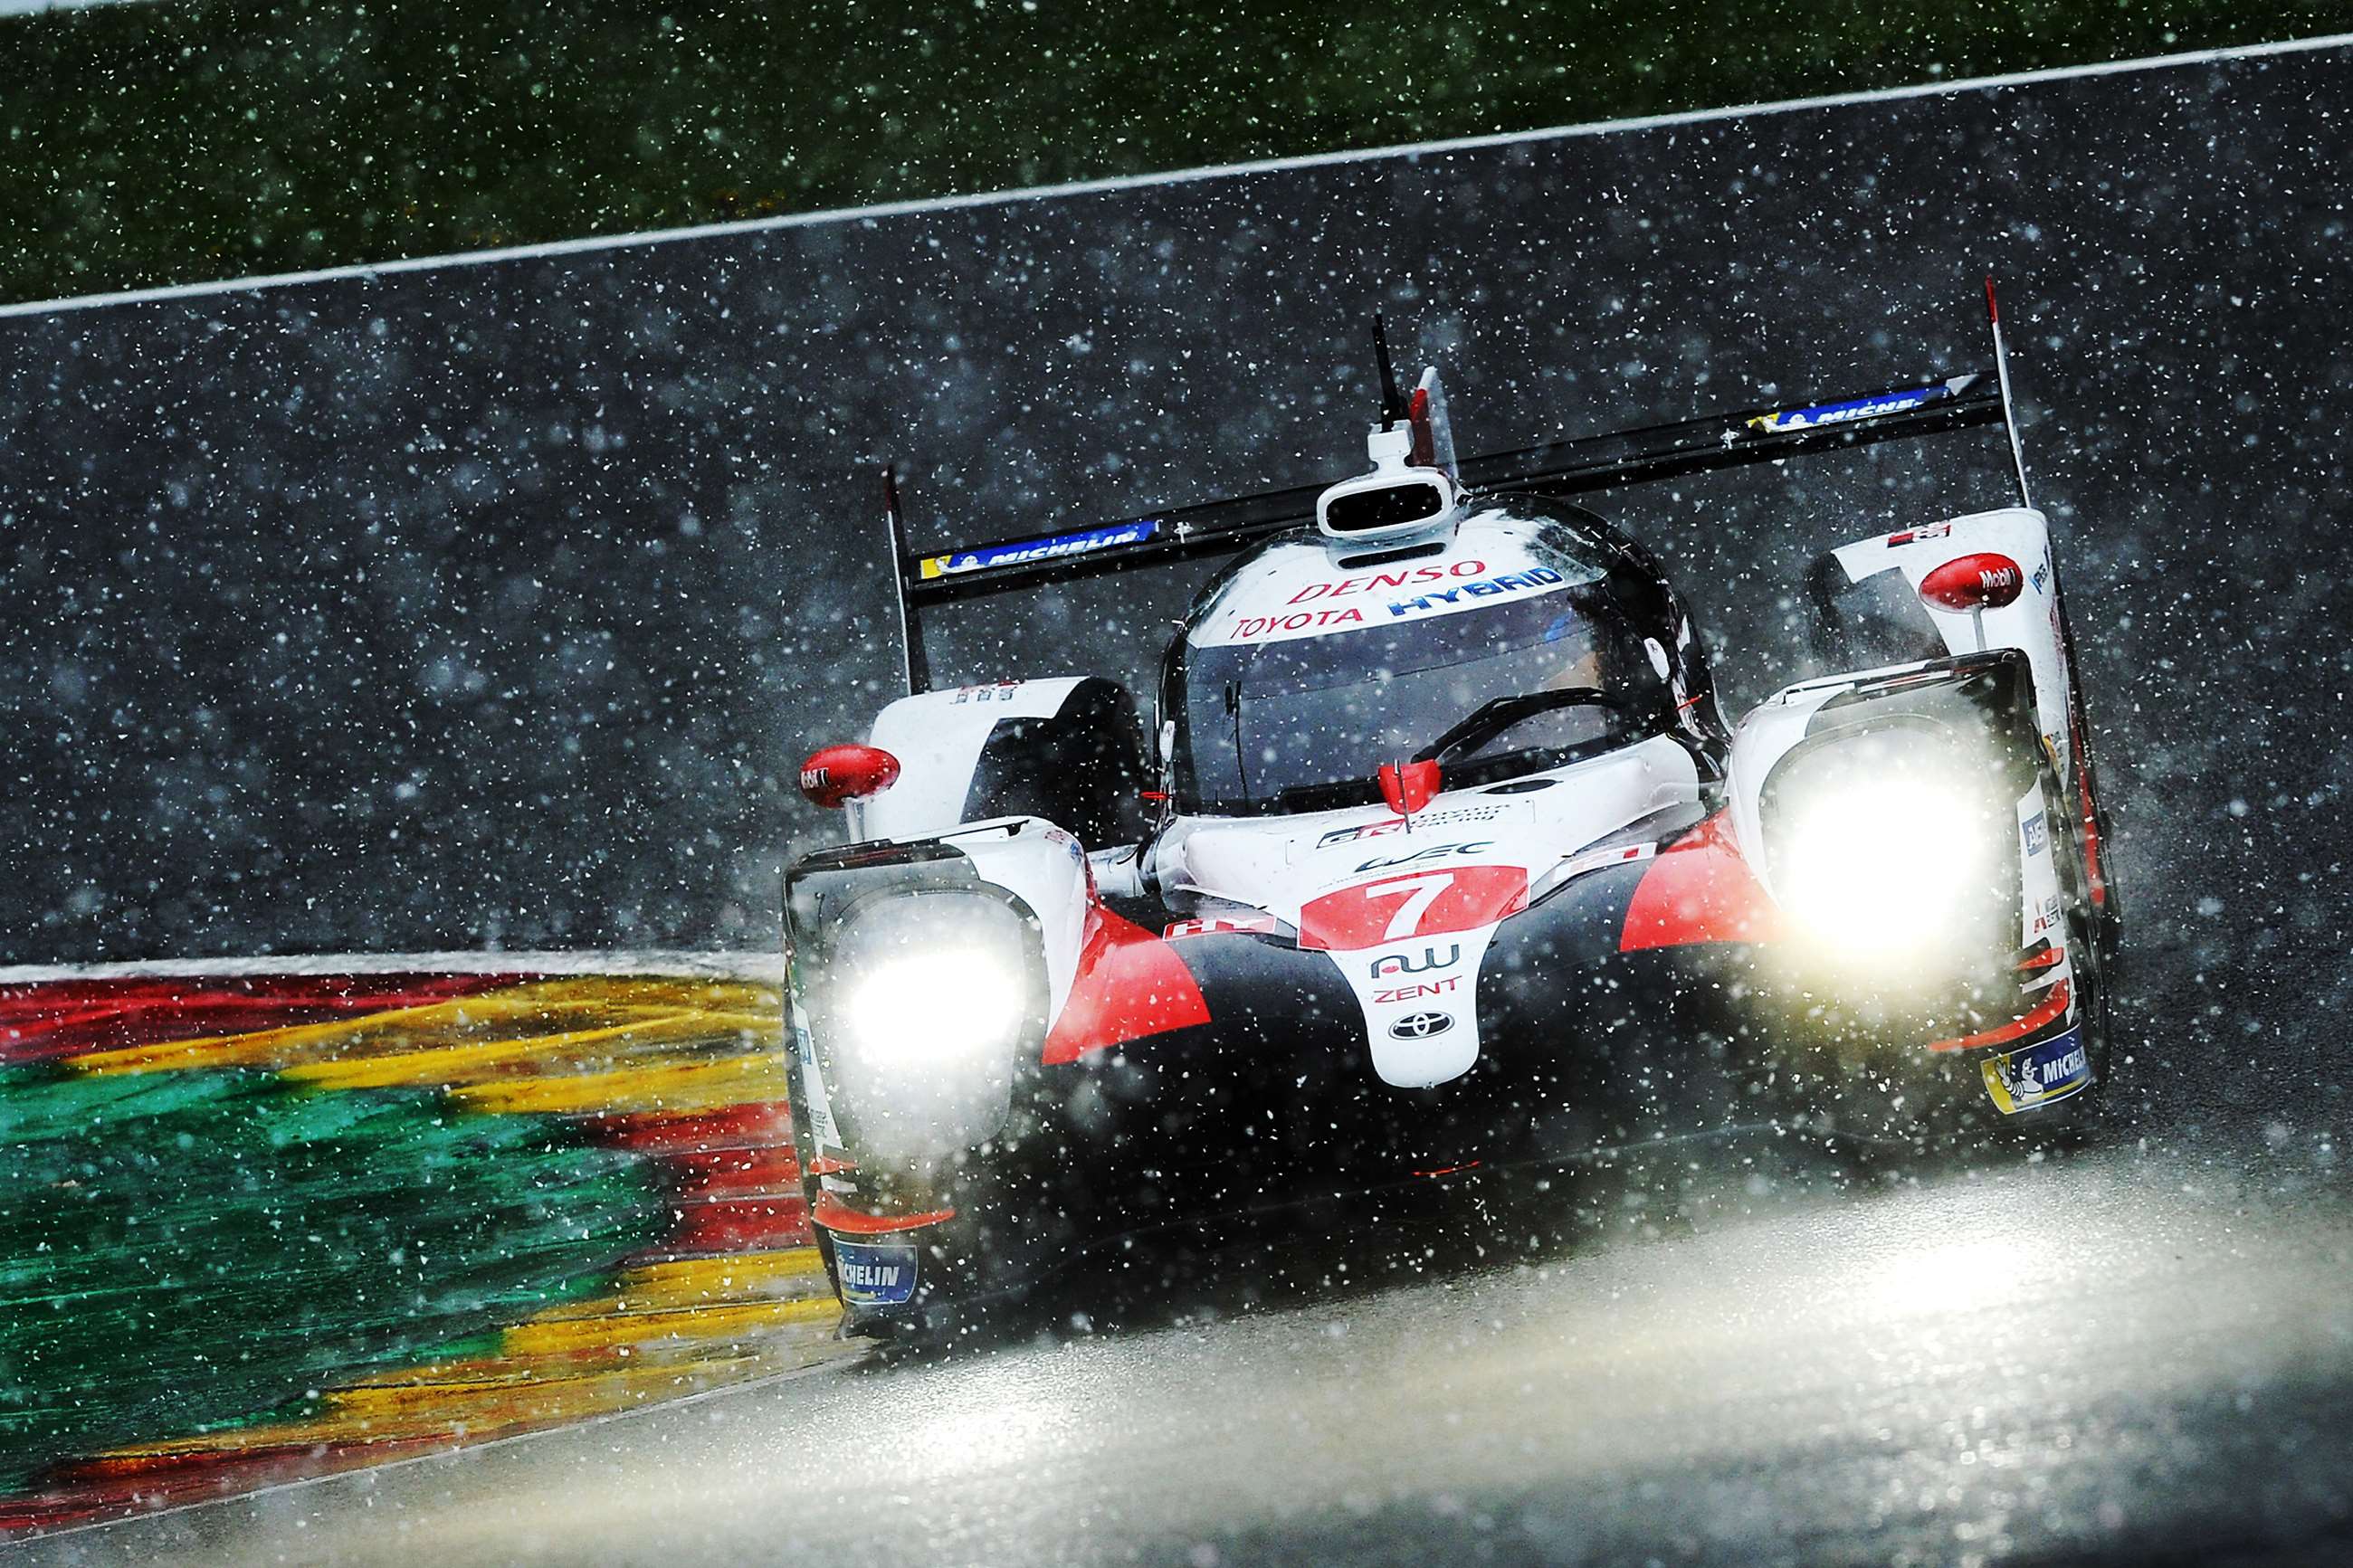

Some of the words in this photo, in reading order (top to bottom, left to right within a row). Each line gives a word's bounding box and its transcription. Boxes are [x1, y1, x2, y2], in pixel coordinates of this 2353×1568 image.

[989, 531, 1138, 565] MICHELIN
[1285, 559, 1486, 605] DENSO
[1230, 607, 1364, 639] TOYOTA
[1386, 566, 1566, 617] HYBRID
[1365, 872, 1454, 941] 7
[1373, 975, 1462, 1003] ZENT
[843, 1262, 900, 1286] CHELIN
